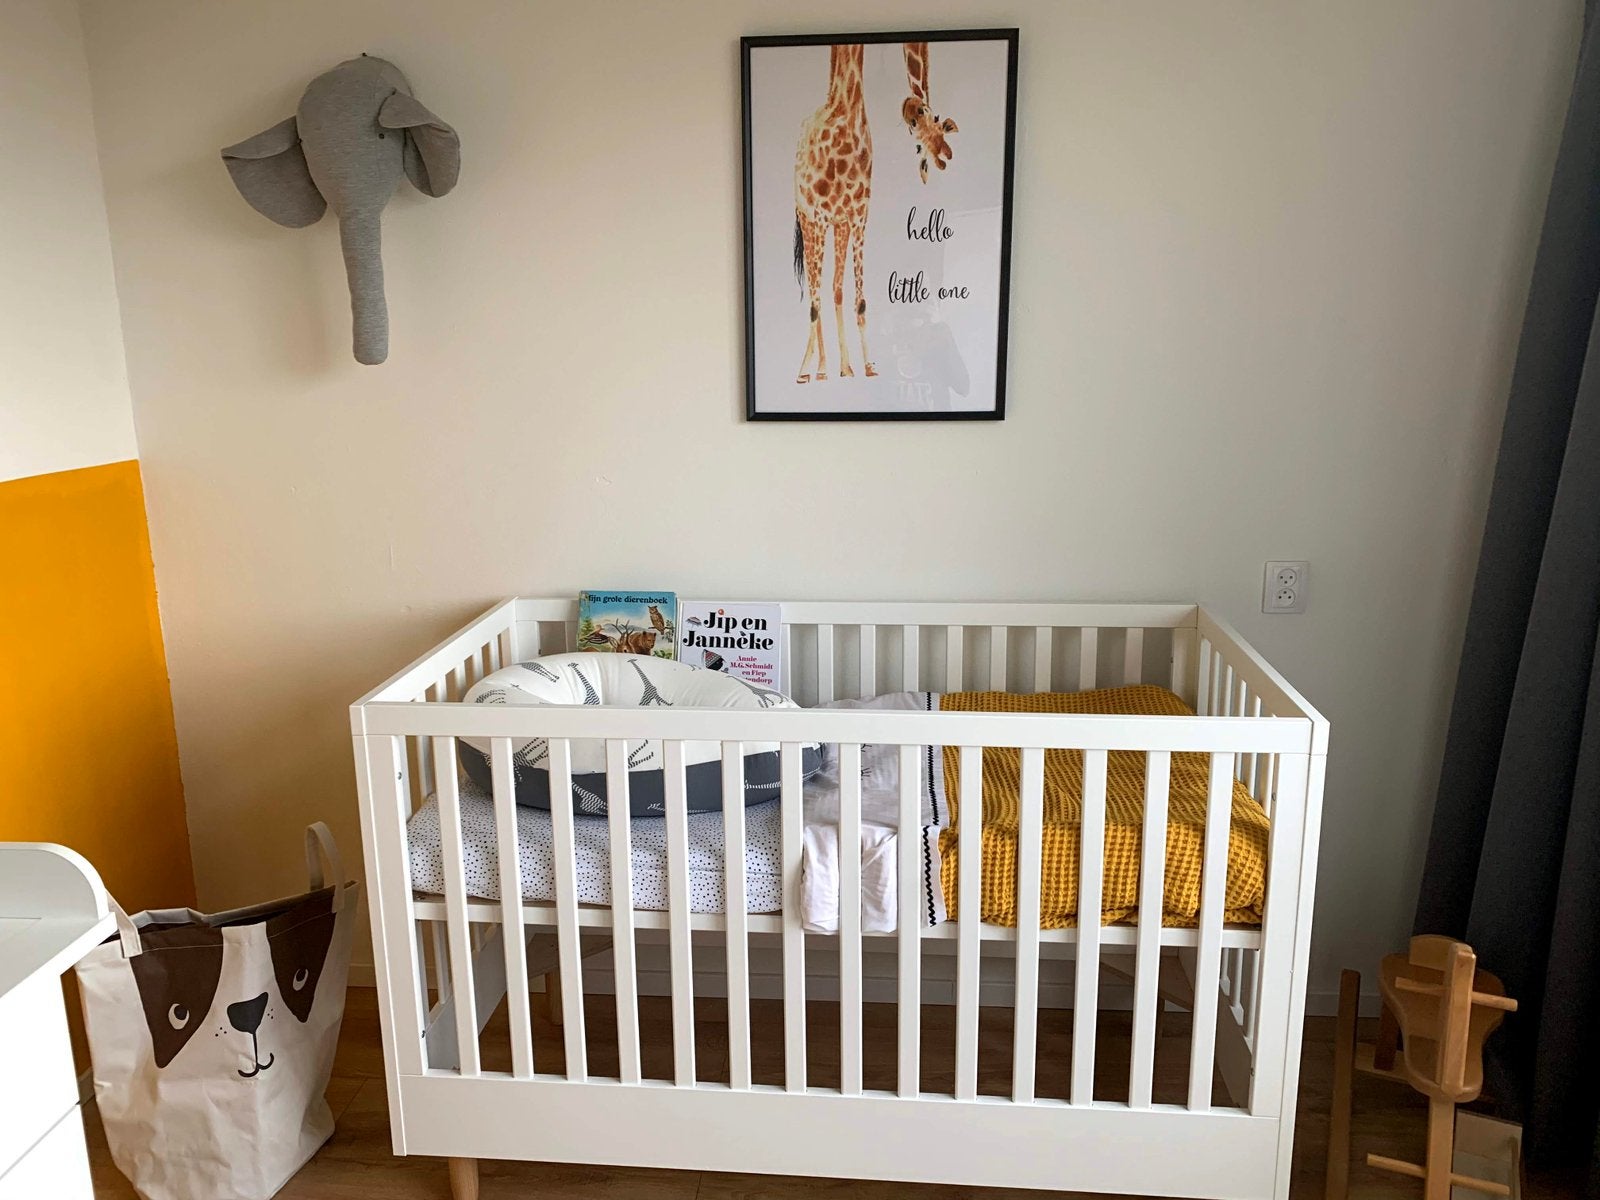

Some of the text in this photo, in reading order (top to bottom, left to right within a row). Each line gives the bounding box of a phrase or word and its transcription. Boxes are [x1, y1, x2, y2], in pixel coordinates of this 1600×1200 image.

[907, 206, 954, 242] hello
[888, 270, 970, 304] little one
[603, 595, 622, 604] grote
[624, 596, 668, 604] dierenboek
[704, 610, 767, 633] Jip en
